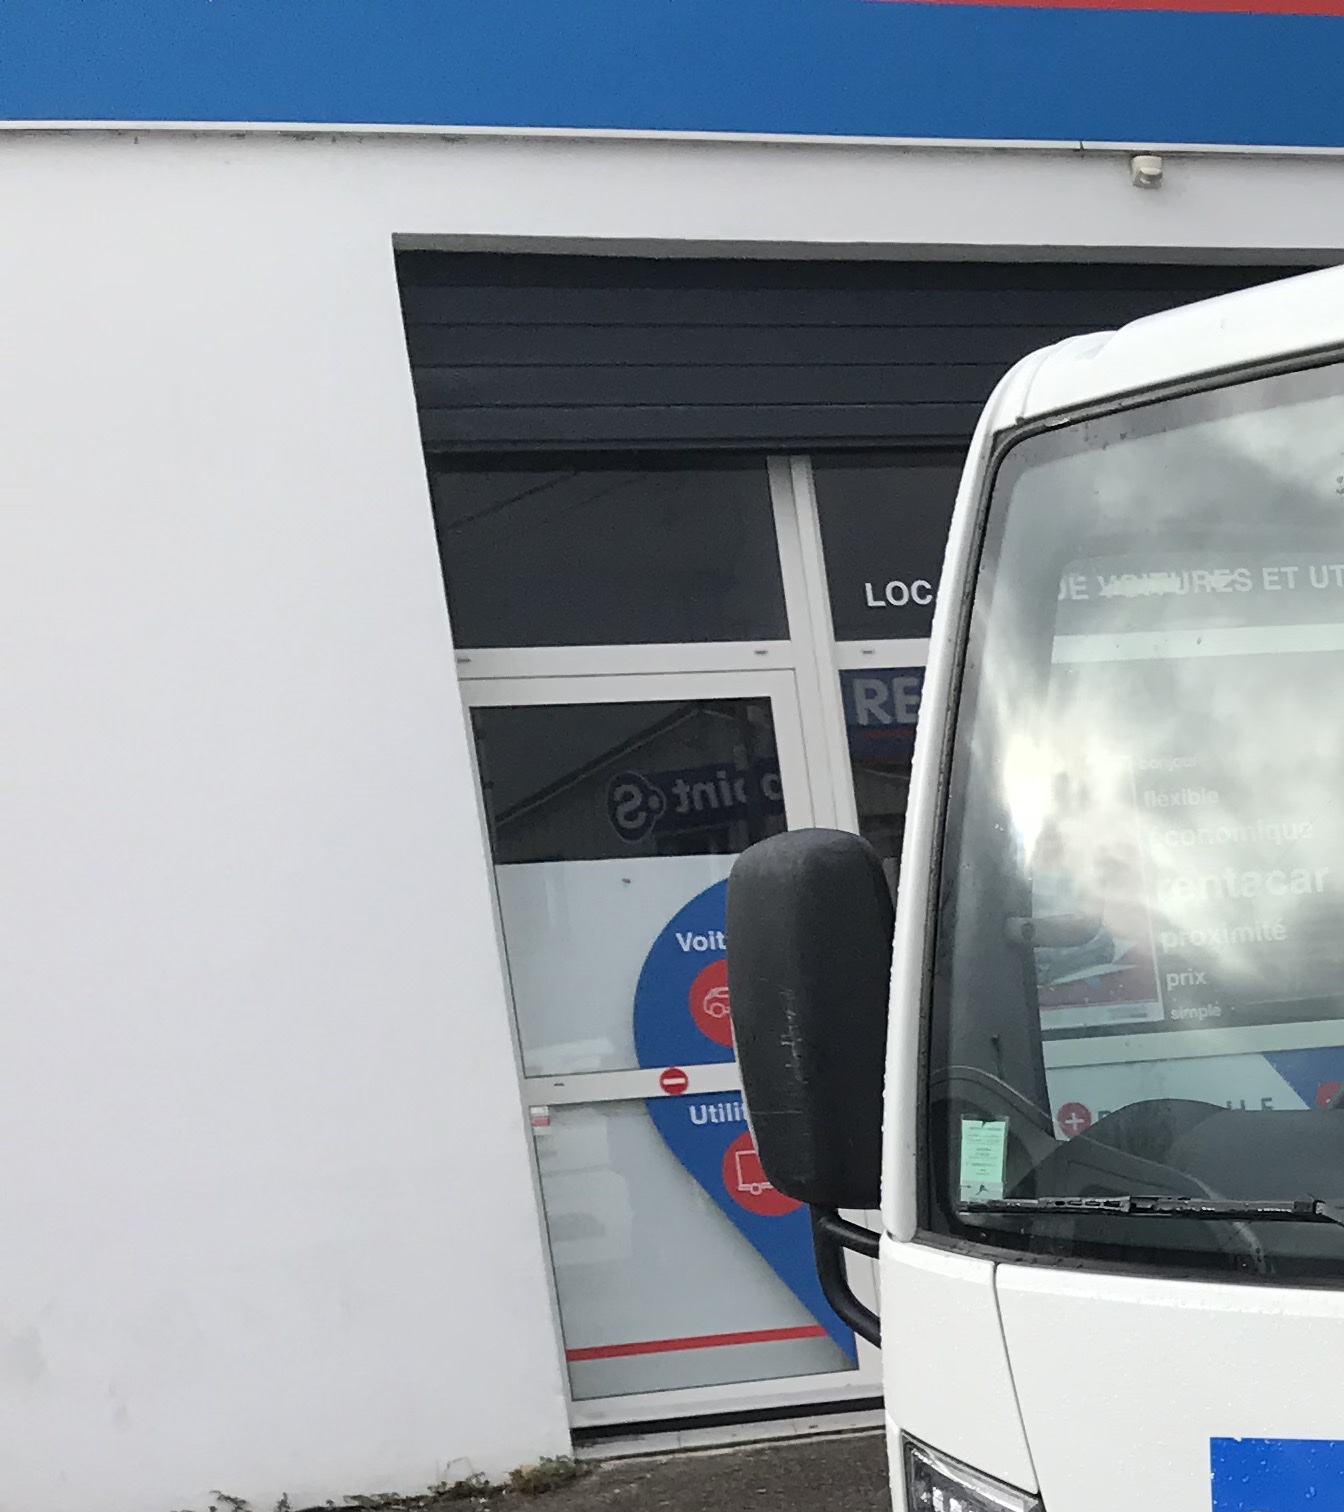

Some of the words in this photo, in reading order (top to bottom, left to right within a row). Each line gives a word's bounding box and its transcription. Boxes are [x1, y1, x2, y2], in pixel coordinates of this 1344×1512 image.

[1263, 566, 1299, 591] ET
[675, 930, 727, 952] Voit
[1159, 918, 1287, 952] proximité
[1166, 968, 1207, 991] prix
